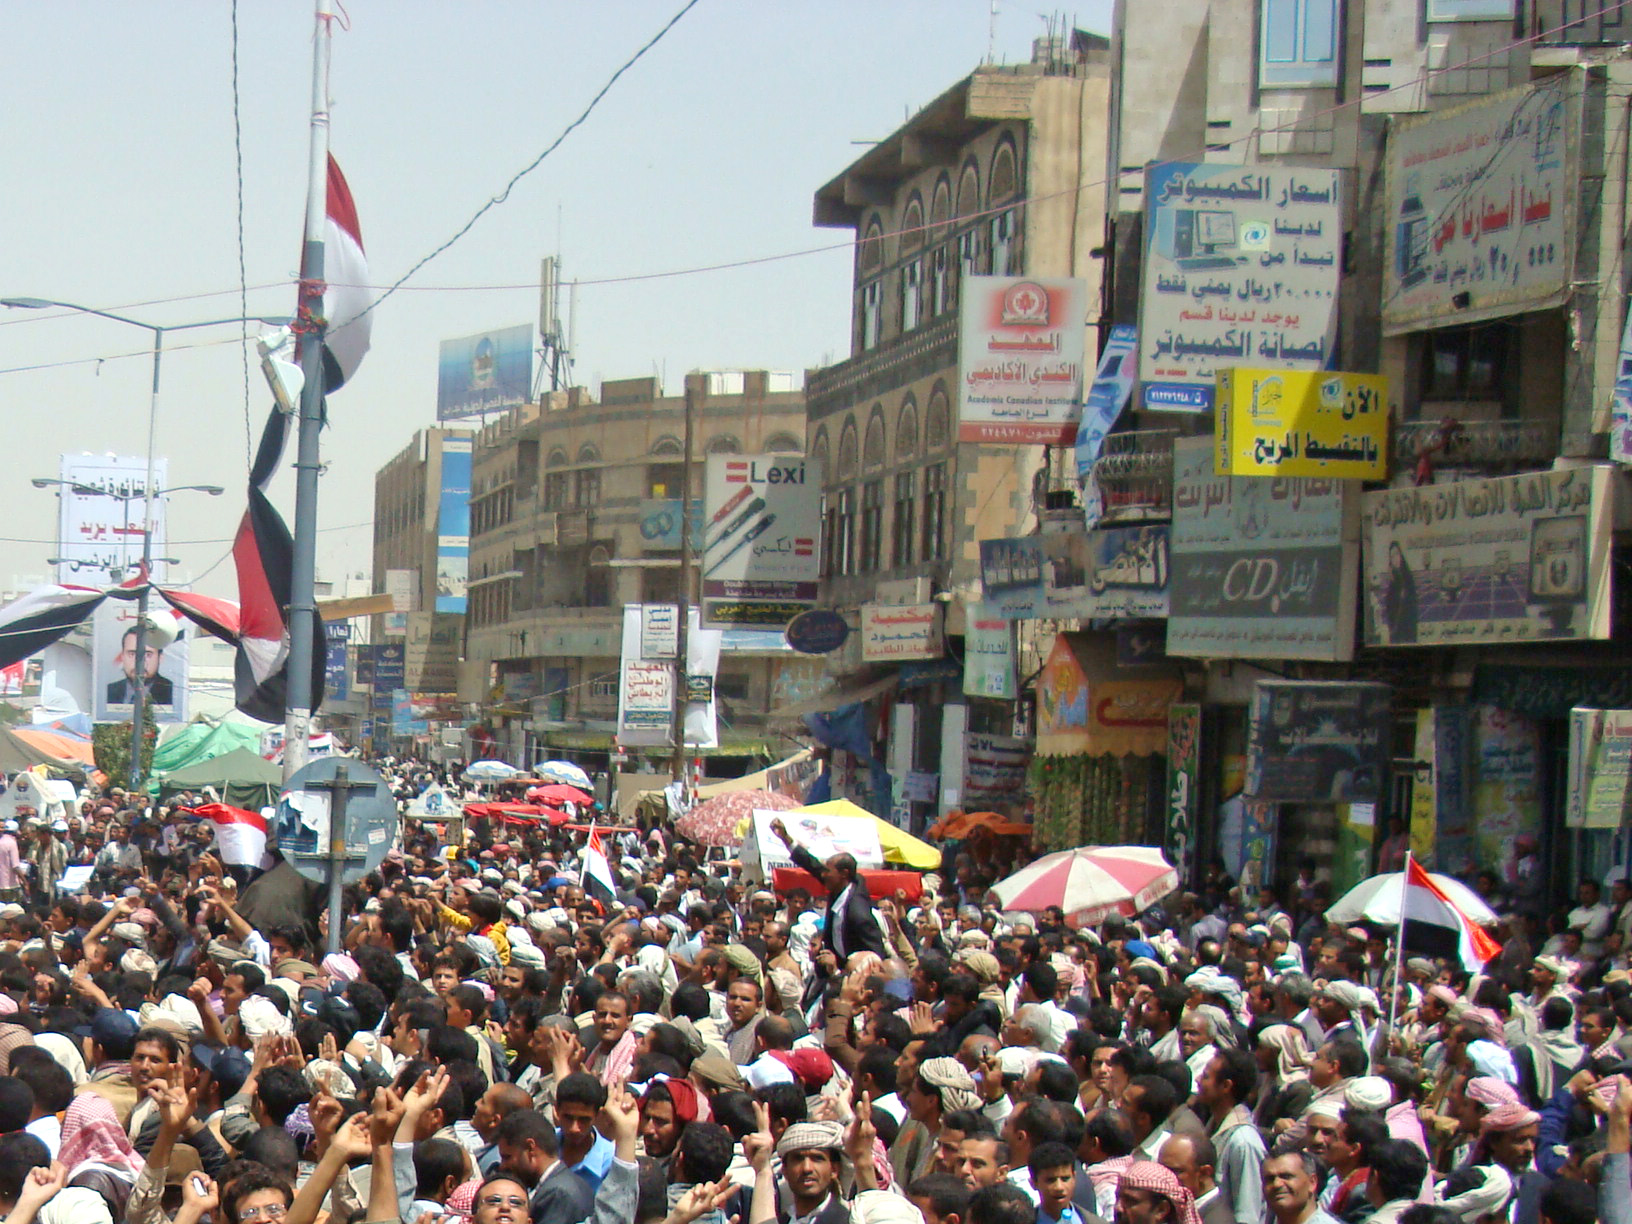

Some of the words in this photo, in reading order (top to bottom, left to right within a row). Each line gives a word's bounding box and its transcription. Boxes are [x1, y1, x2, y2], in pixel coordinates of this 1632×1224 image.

[1157, 172, 1270, 204] الكمبيوتر
[1276, 172, 1338, 208] أسعار
[1274, 217, 1322, 240] لدينا
[1260, 251, 1285, 267] من
[1294, 243, 1334, 270] تبدأ
[1156, 273, 1187, 293] فقط
[1191, 279, 1232, 303] يمني
[1179, 304, 1213, 322] قسم
[1219, 307, 1256, 326] لدينا
[1261, 310, 1300, 329] يوجد
[987, 332, 1060, 352] المعهد
[1150, 329, 1252, 361] الكمبيوتر
[1029, 361, 1076, 392] الكندي
[1006, 395, 1043, 404] Canadian
[1254, 431, 1299, 465] المريح
[1305, 432, 1378, 468] بالتقسيط
[750, 461, 806, 485] Lexi
[80, 521, 107, 540] يريد
[628, 662, 670, 673] المعهد
